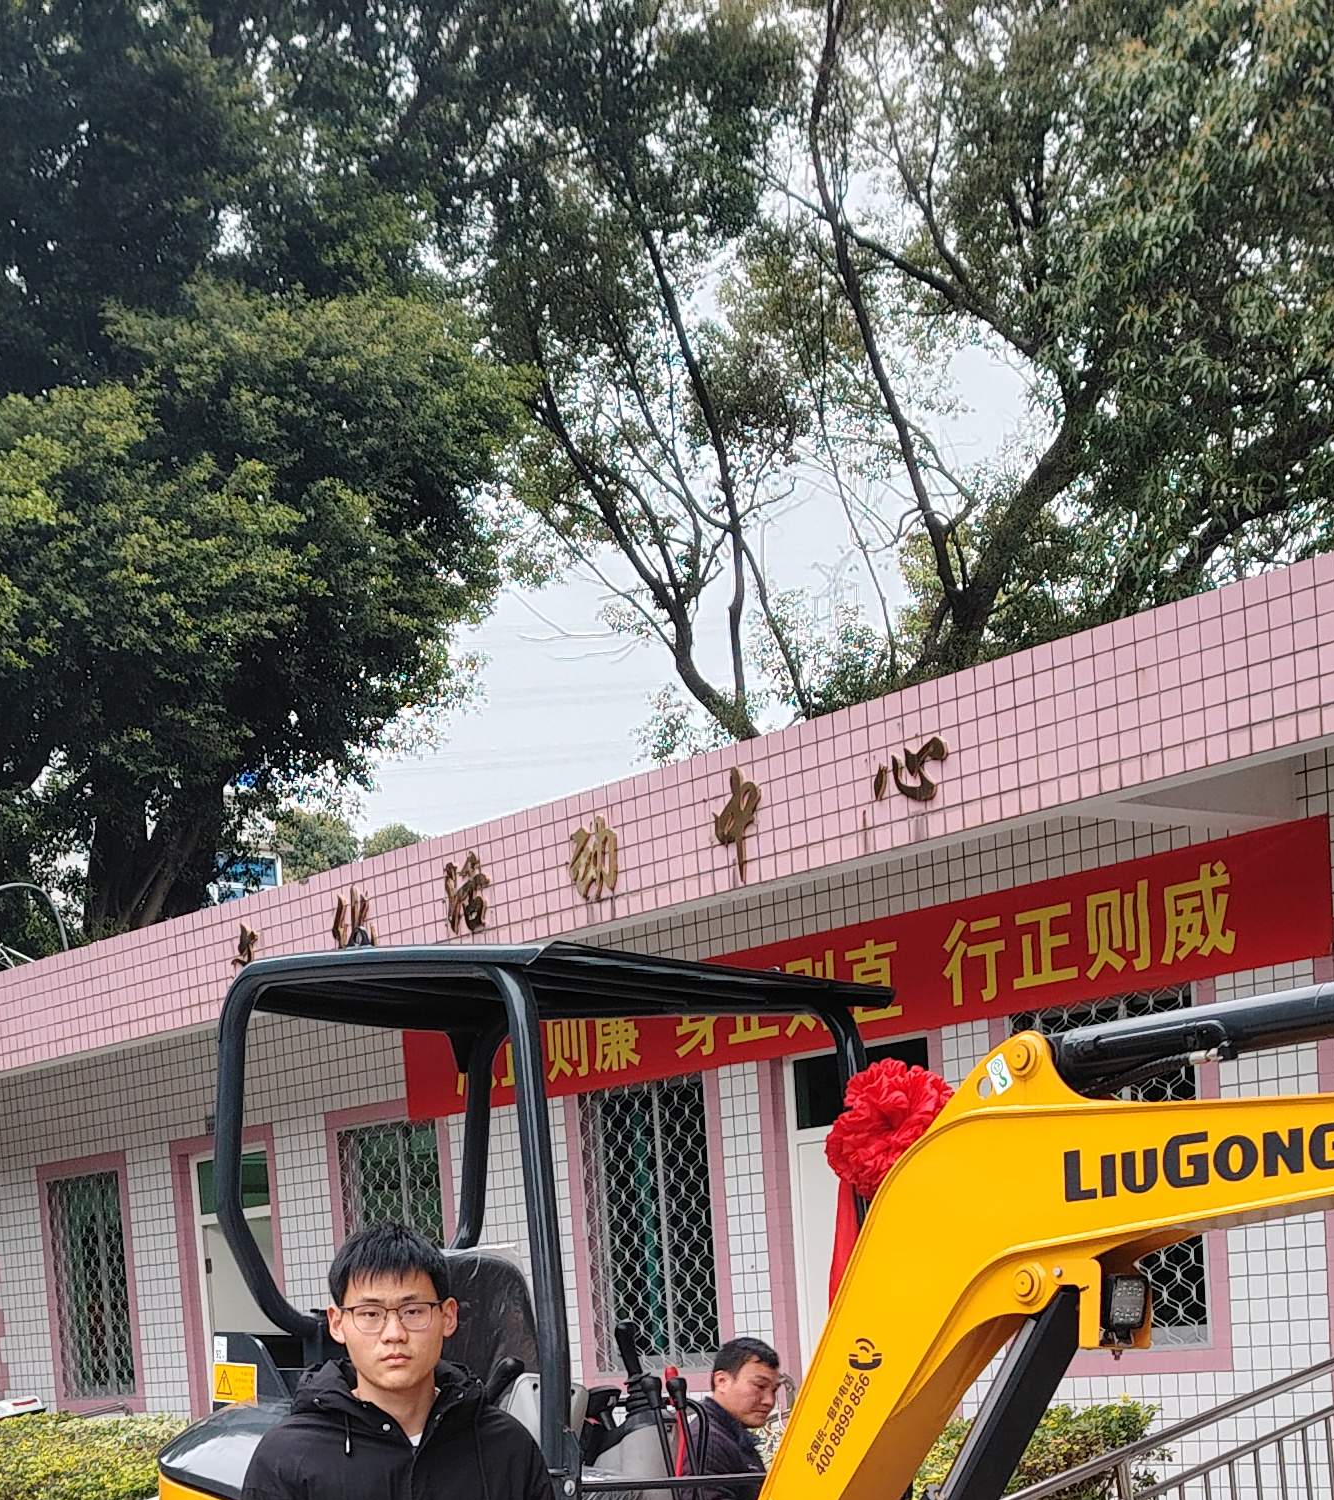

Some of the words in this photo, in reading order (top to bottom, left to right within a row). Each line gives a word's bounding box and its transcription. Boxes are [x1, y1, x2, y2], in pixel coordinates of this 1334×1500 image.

[941, 860, 1236, 1008] 行正则威
[806, 1371, 855, 1466] 全国统一服务电话
[815, 1444, 835, 1476] 400
[829, 1404, 855, 1446] 8899
[849, 1372, 871, 1407] 856
